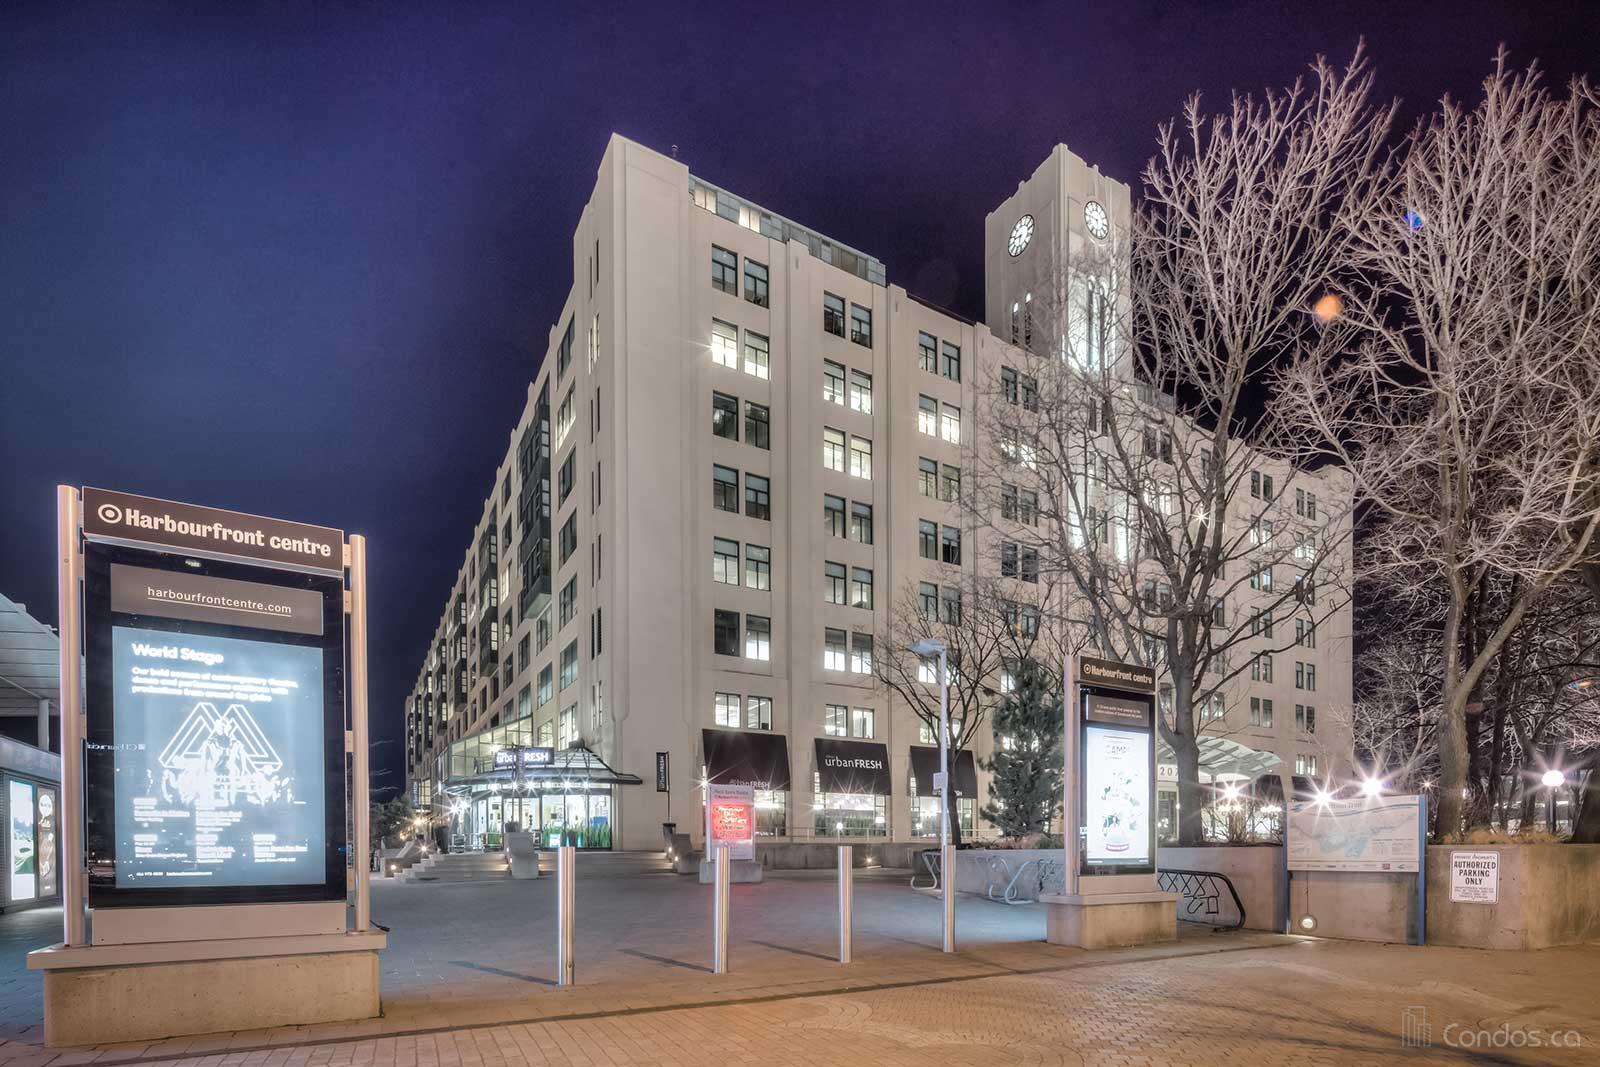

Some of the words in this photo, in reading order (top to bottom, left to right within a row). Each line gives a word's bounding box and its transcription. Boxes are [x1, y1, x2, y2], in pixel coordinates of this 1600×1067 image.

[126, 508, 265, 547] Harbourfront
[270, 535, 332, 558] centre
[147, 586, 292, 614] harbourfrontcentre.com
[131, 643, 178, 660] World
[180, 647, 225, 666] Stage
[1091, 665, 1132, 681] Harbourfront
[1133, 674, 1153, 684] centre
[824, 755, 883, 770] urbanFRESH
[1454, 861, 1496, 869] AUTHORIZED
[1458, 869, 1490, 877] PARKING
